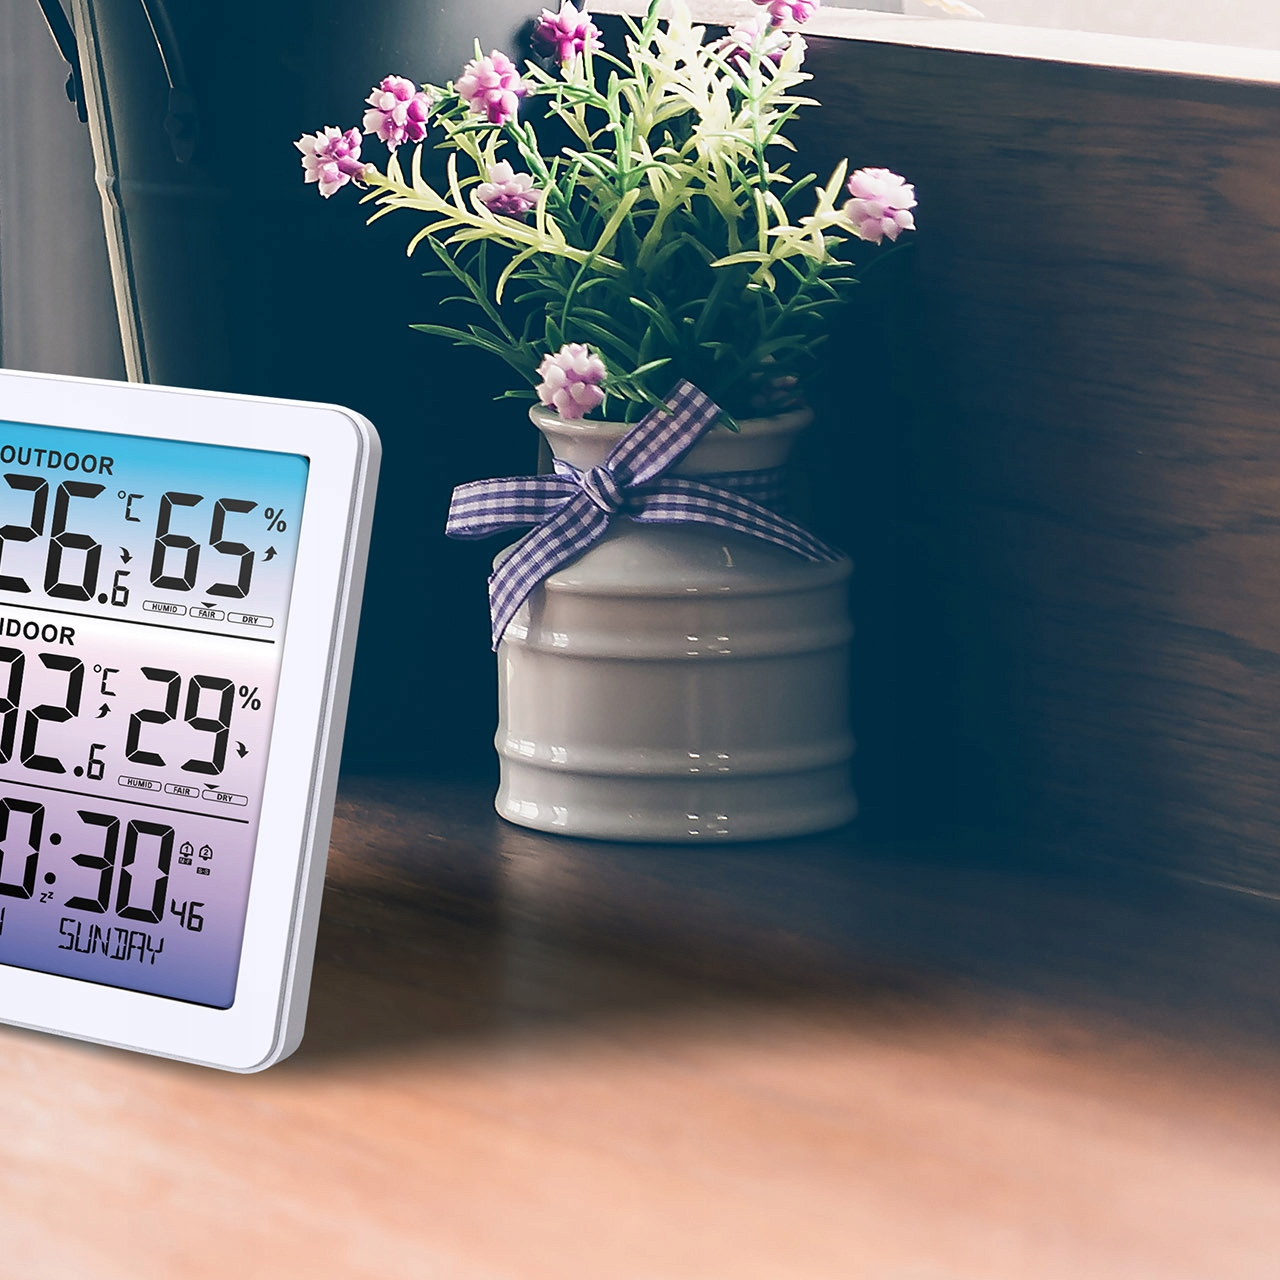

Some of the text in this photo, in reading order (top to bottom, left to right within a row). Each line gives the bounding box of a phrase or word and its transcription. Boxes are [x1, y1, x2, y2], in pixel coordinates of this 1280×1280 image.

[0, 444, 115, 476] OUTDOOR
[151, 602, 259, 626] HUMID FAIR DRY
[126, 777, 234, 803] HUMID FAIR DRY
[170, 898, 206, 933] 46
[58, 917, 166, 966] SUNDAY
